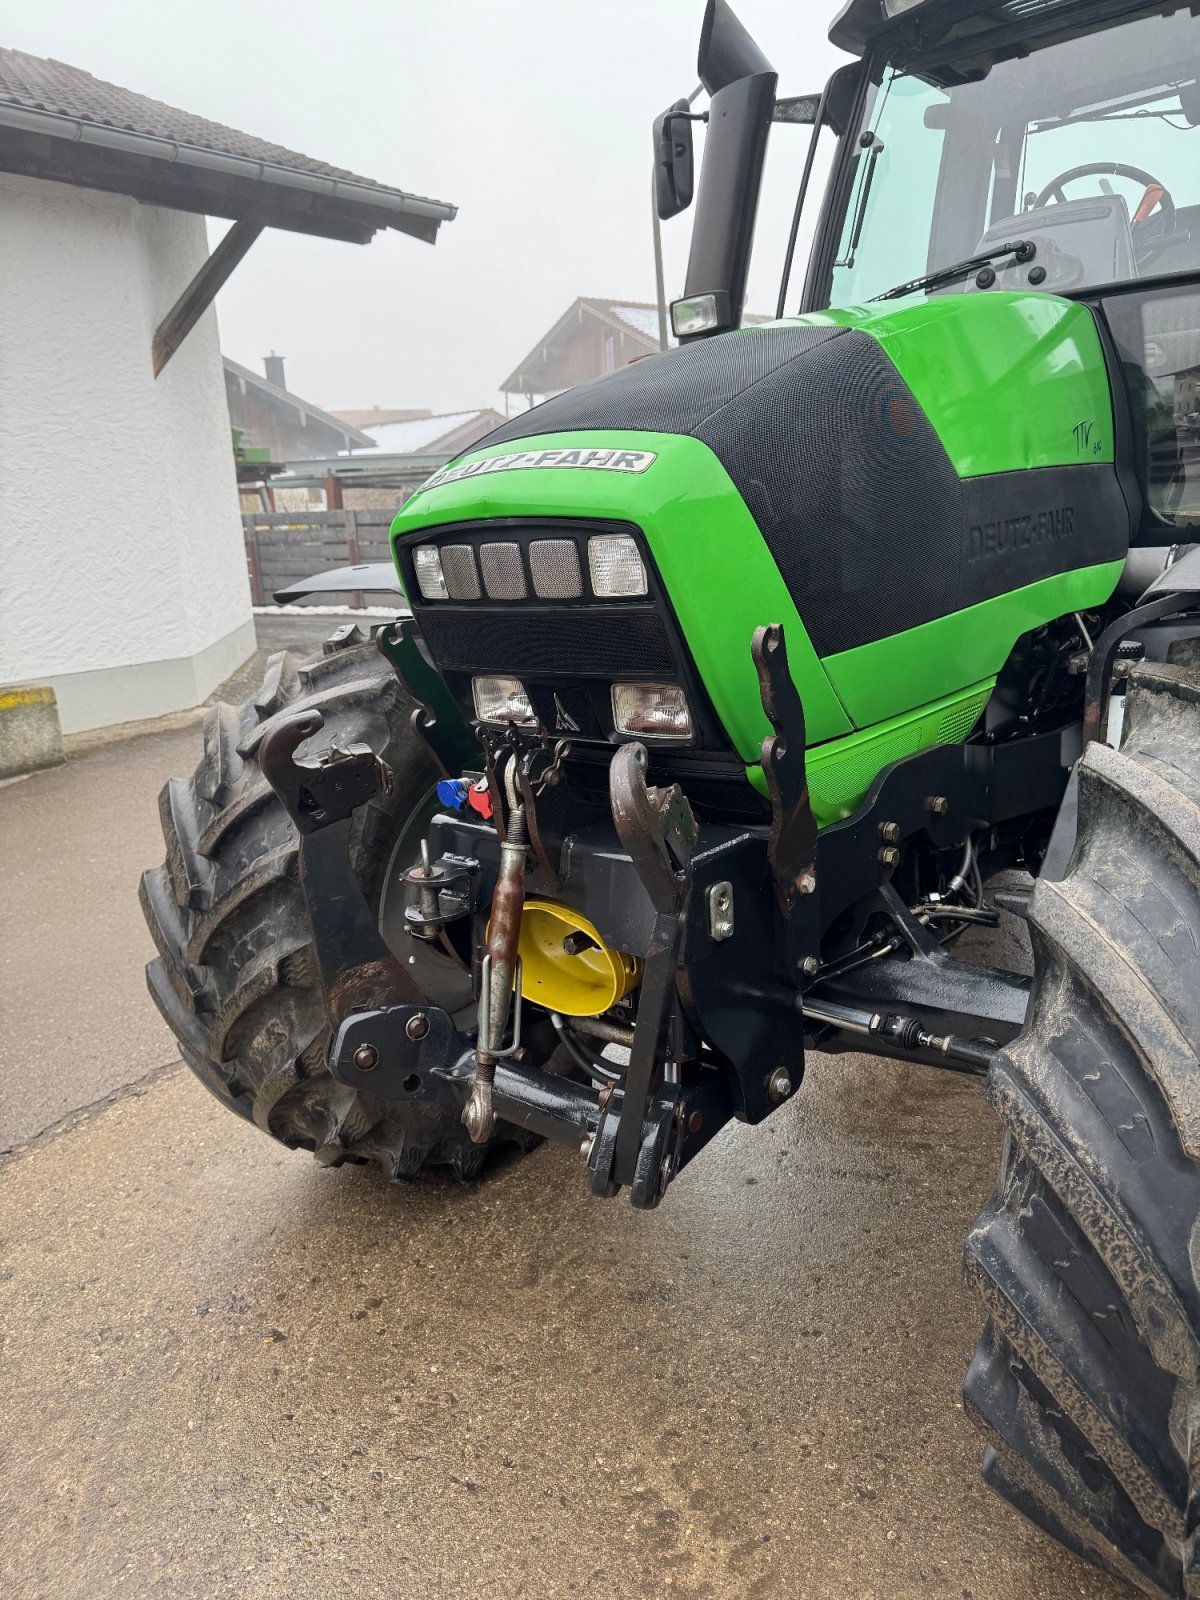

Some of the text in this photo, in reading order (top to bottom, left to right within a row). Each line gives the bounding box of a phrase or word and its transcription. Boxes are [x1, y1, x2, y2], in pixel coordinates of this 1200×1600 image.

[1073, 417, 1097, 456] TTV
[424, 450, 645, 487] DEUTZ-FAHR
[967, 506, 1075, 561] DEUTZ-FAHR
